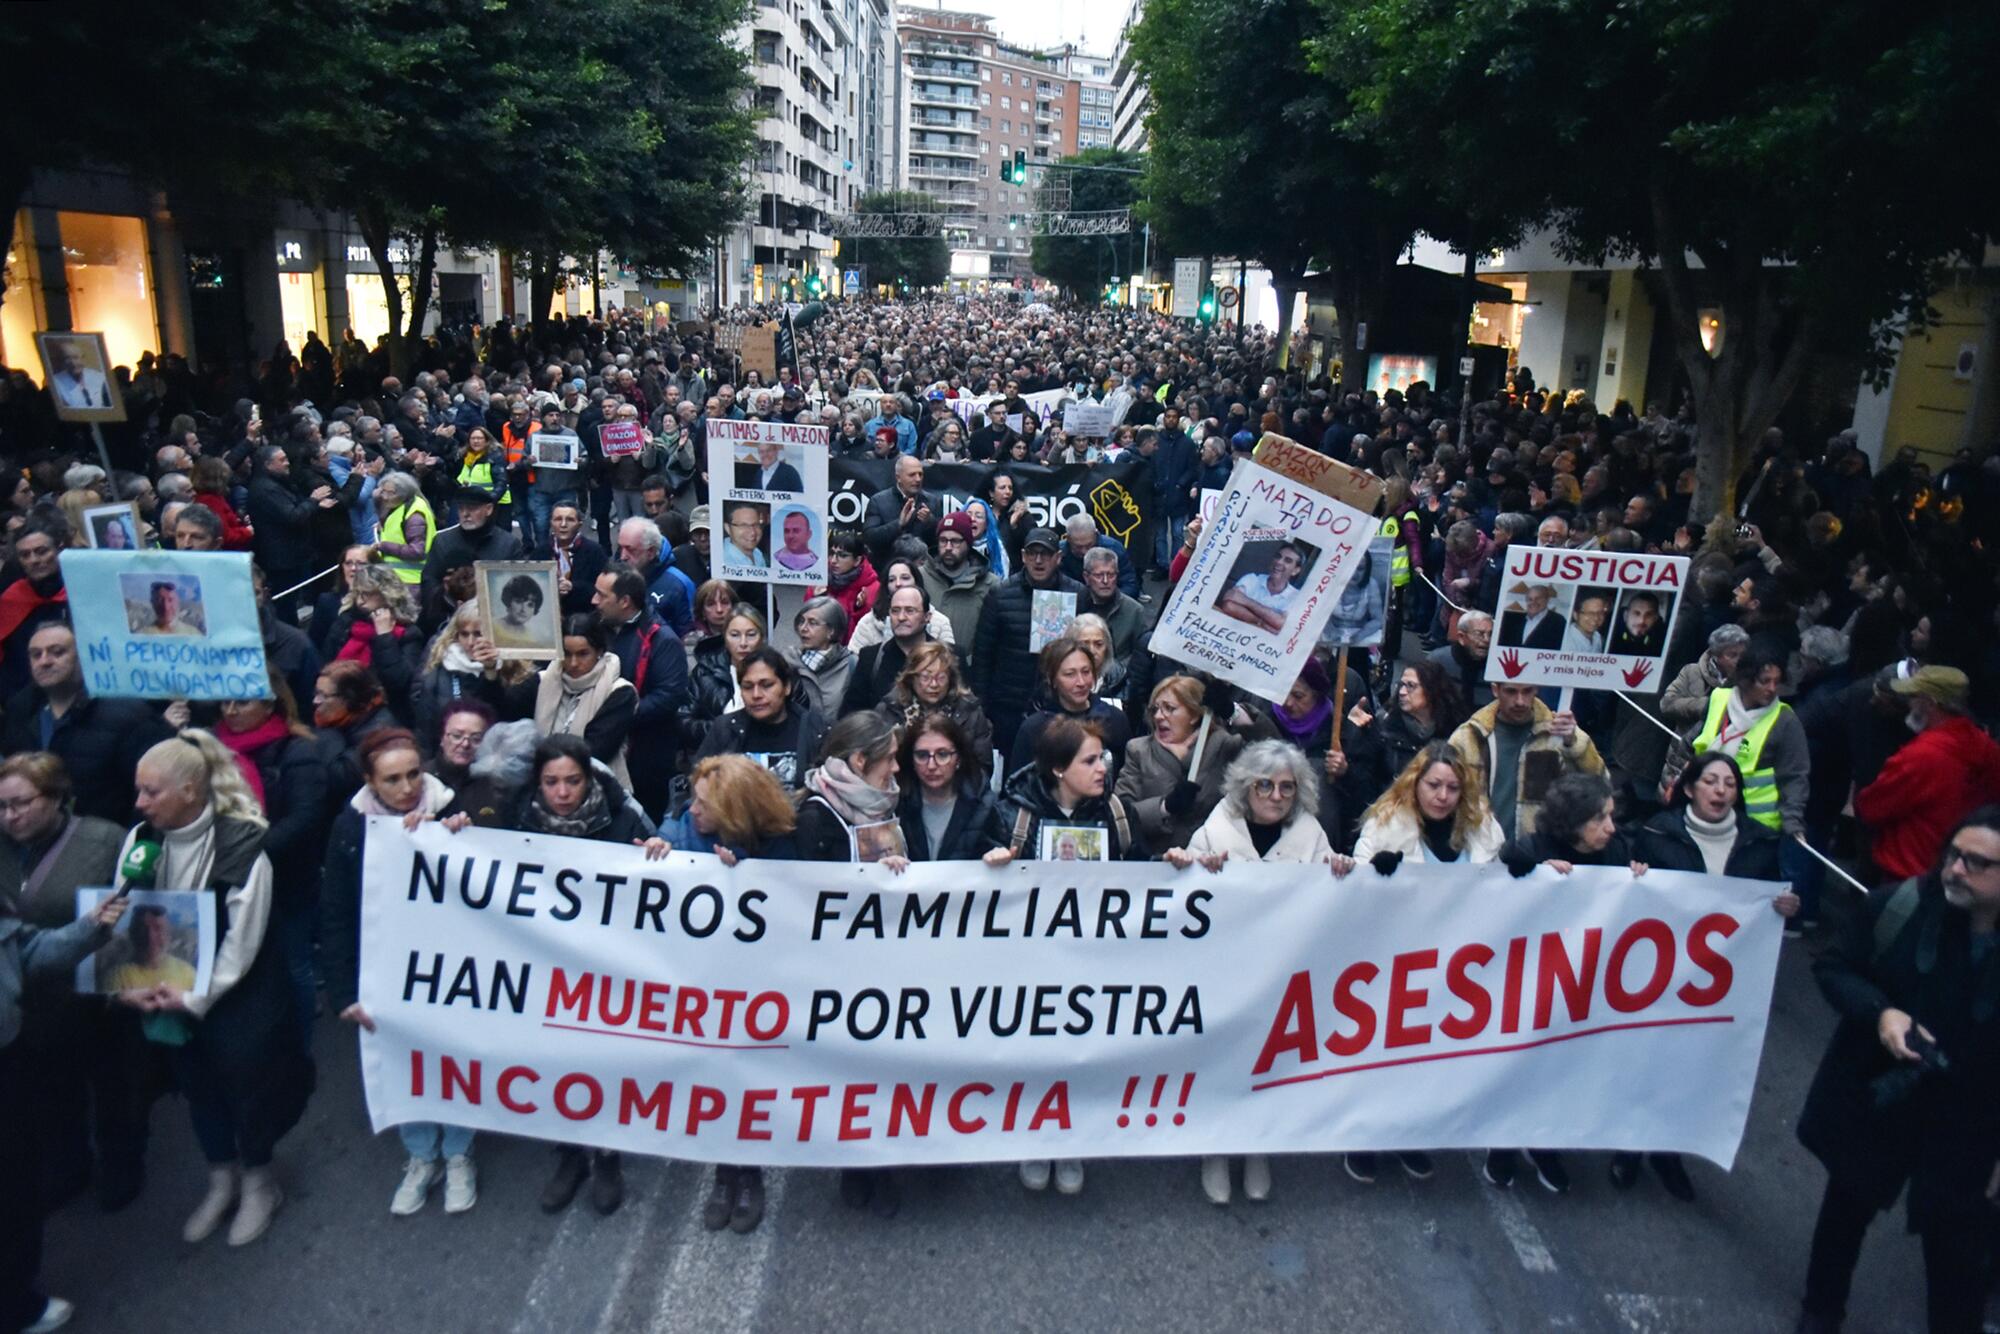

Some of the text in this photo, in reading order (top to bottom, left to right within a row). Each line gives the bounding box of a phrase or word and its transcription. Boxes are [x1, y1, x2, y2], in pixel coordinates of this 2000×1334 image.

[1268, 441, 1334, 474] MAZON
[729, 489, 765, 500] EMETERIO
[1252, 480, 1351, 534] MATADO
[1511, 552, 1679, 587] JUSTICIA
[126, 641, 263, 669] PERDONAMOS
[1176, 626, 1278, 676] NUESTROS AMADOS
[1256, 642, 1282, 659] CON
[1537, 651, 1617, 665] por mi marido
[1543, 665, 1604, 677] y mis hijos
[407, 850, 1214, 942] NUESTROS FAMILIARES
[402, 951, 1204, 1042] HAN MUERTO POR VUESTRA
[1251, 912, 1740, 1076] ASESINOS
[411, 1049, 1196, 1142] INCOMPETENCIA !!!
